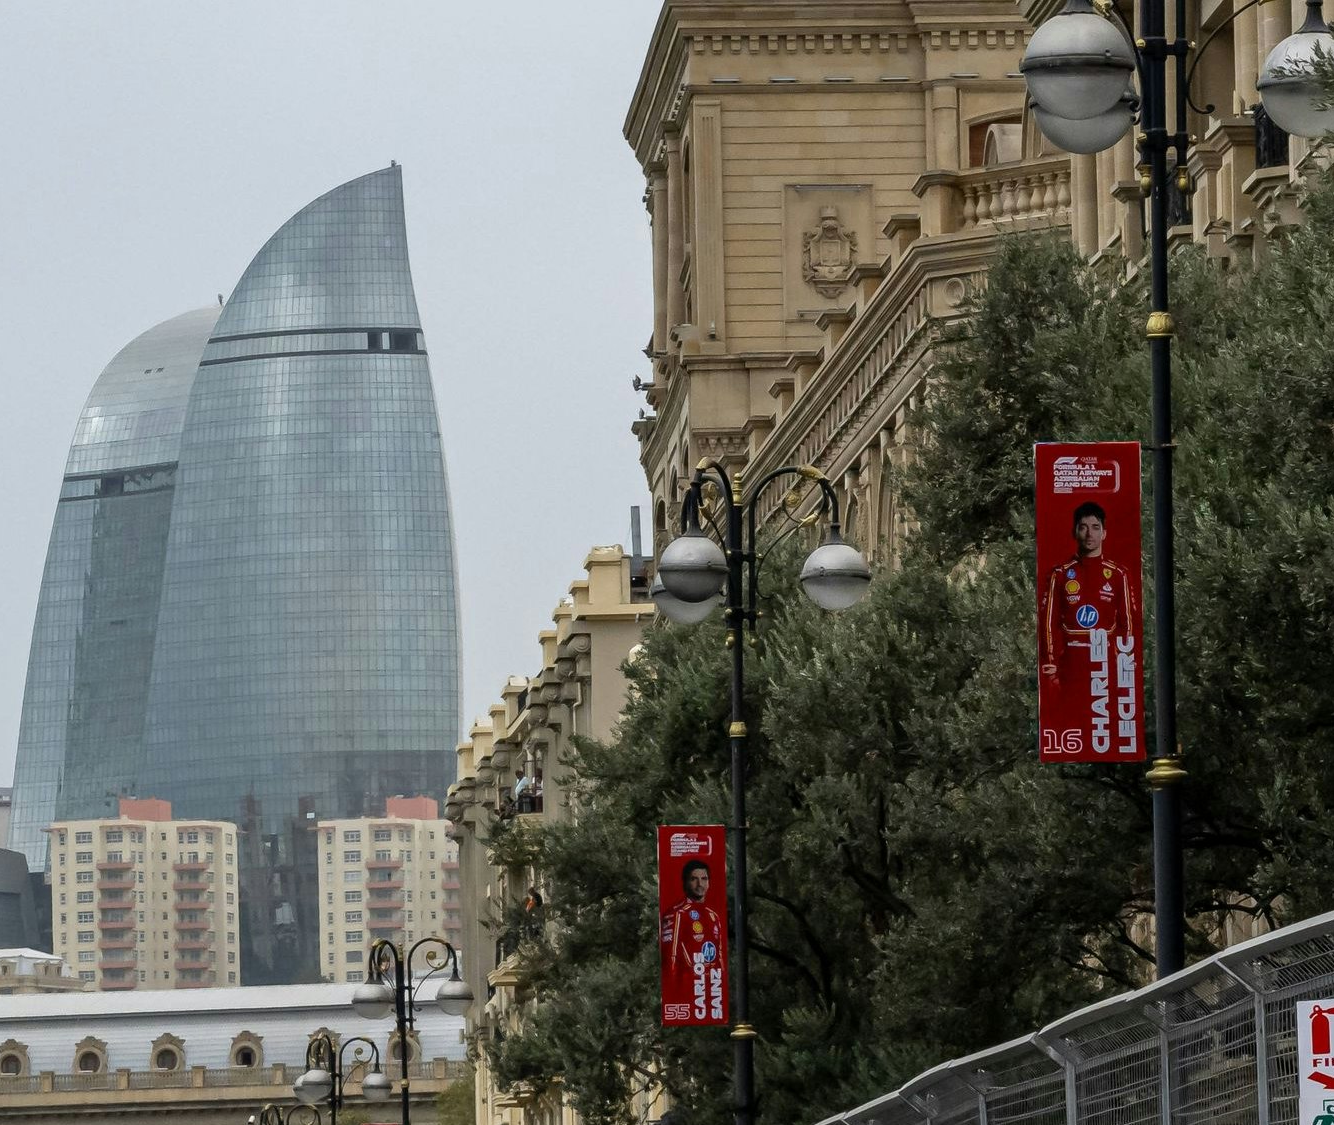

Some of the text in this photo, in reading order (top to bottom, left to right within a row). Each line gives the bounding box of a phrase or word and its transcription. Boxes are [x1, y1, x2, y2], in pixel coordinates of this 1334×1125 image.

[1090, 628, 1111, 754] CHARLES
[1117, 635, 1137, 754] LECLERC
[1043, 729, 1083, 754] 16
[664, 1004, 691, 1020] 55
[693, 952, 706, 1020] CARLOS
[711, 967, 723, 1020] SAINZ
